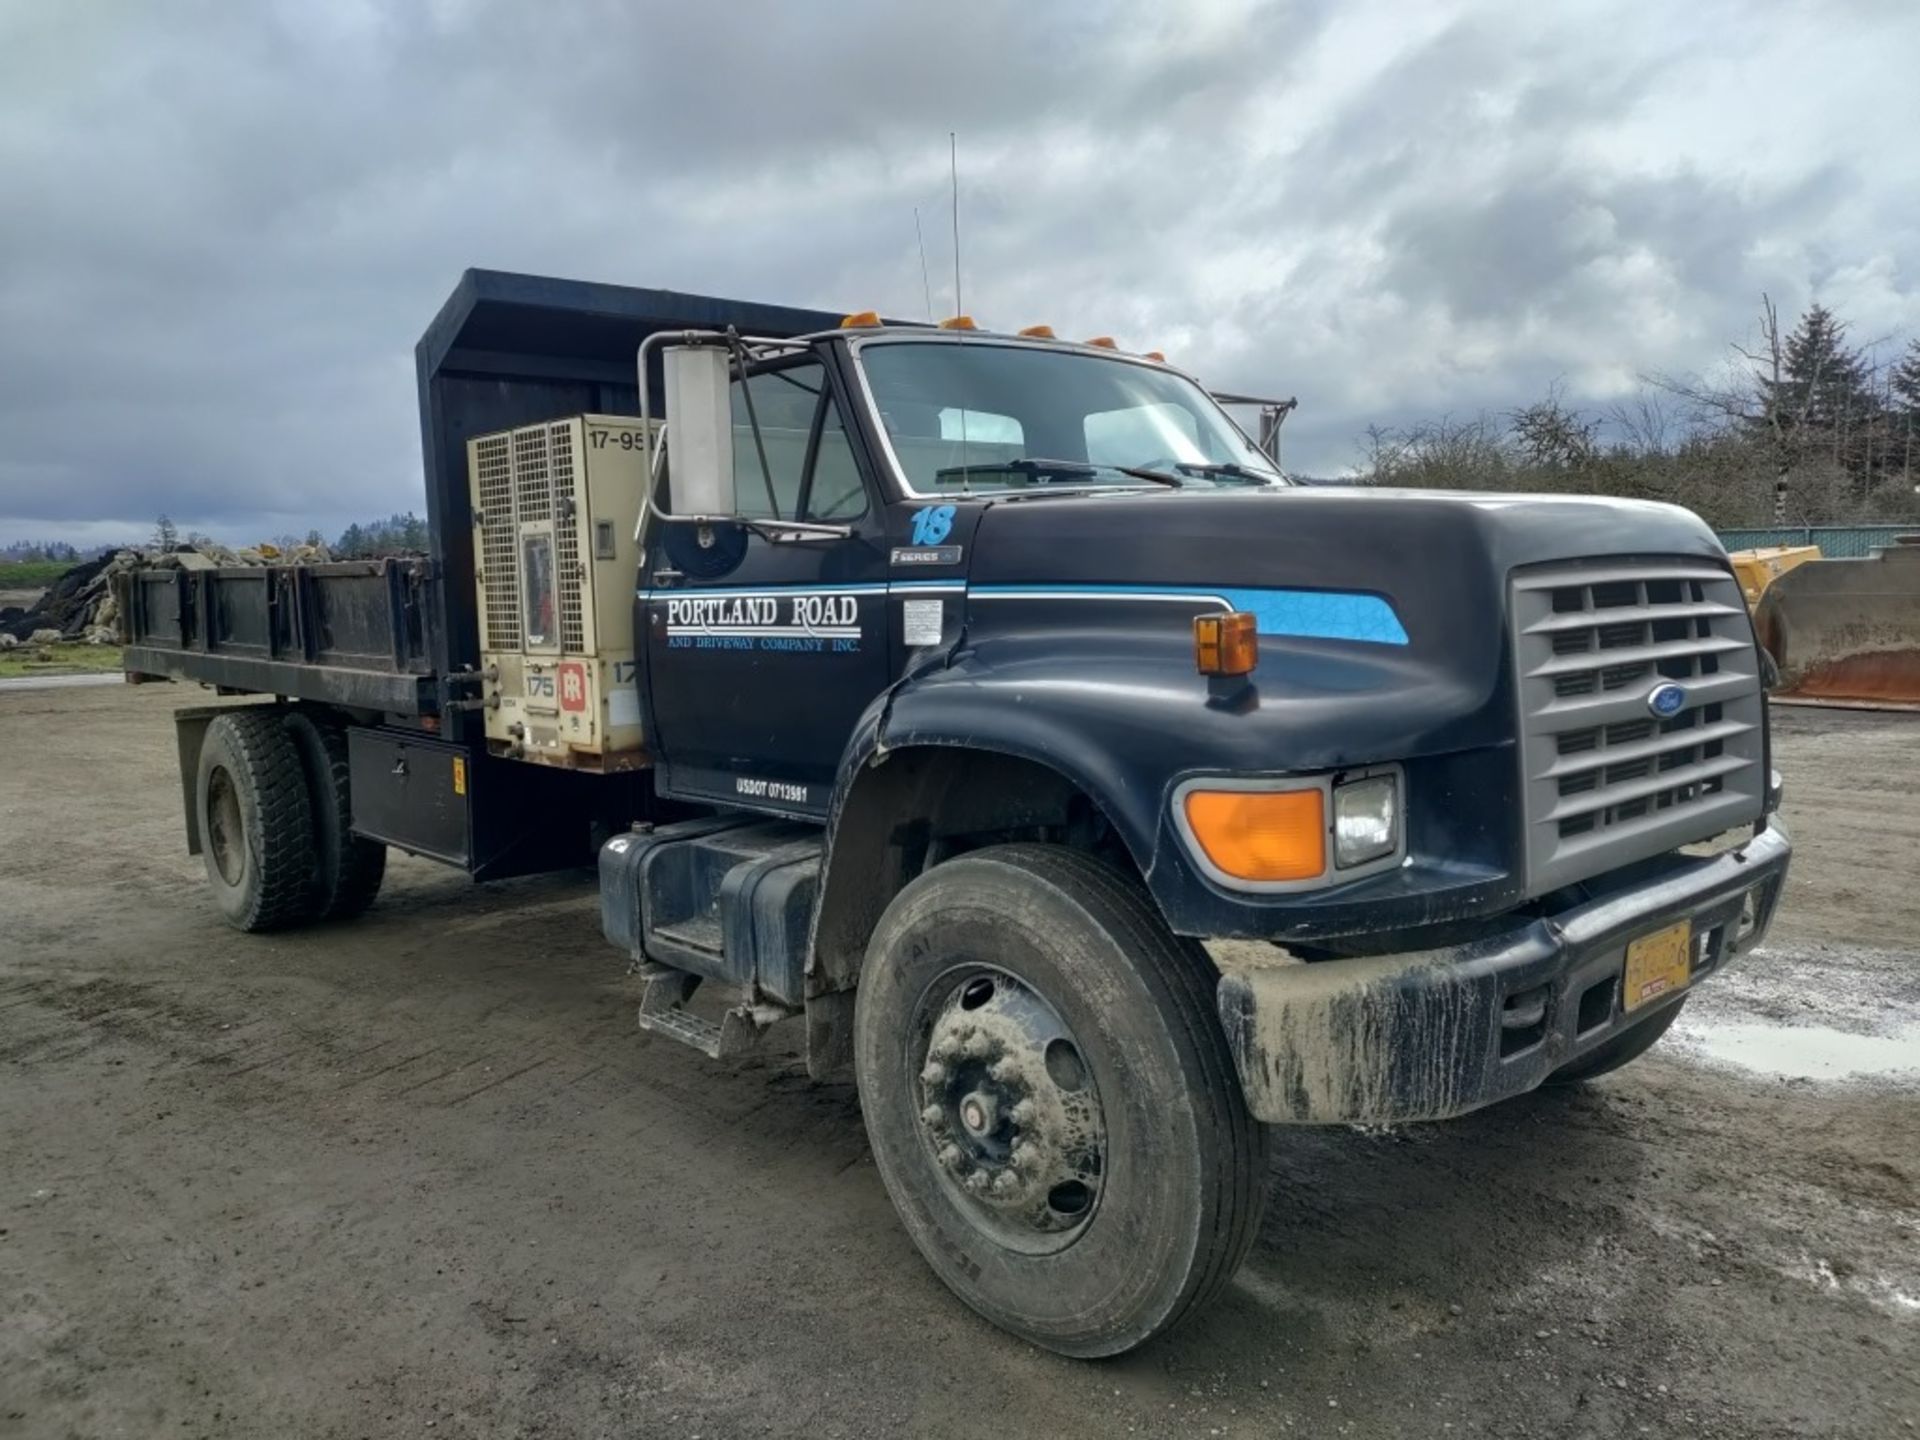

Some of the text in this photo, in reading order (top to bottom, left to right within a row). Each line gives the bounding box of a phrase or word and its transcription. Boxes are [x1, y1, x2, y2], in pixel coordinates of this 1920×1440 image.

[911, 505, 957, 546] 18
[667, 597, 858, 626] PORTLAND ROAD
[668, 637, 691, 648] AND
[696, 637, 754, 650] DRIVEWAY
[760, 639, 824, 651] COMPANY
[736, 777, 767, 796] USDOT
